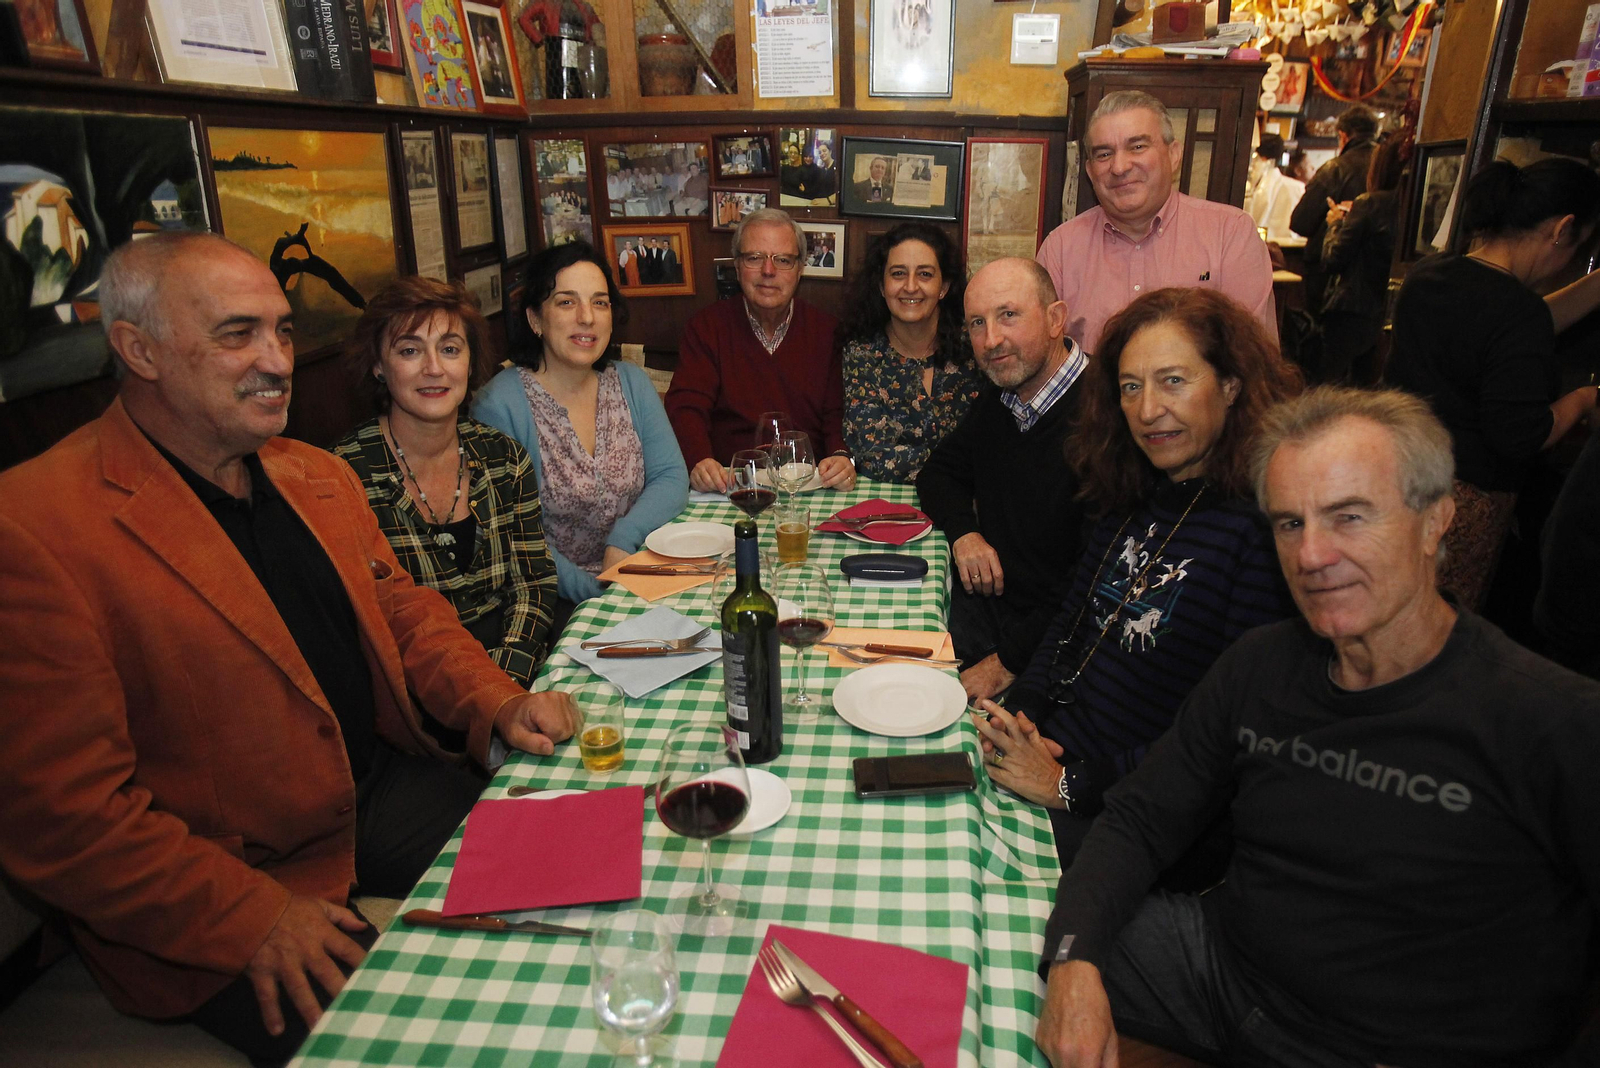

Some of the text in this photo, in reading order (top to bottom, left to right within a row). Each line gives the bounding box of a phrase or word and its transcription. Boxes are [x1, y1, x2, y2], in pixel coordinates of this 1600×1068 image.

[349, 16, 363, 52] LUIS
[773, 18, 795, 26] LEYES
[797, 17, 810, 25] DEL
[1291, 735, 1473, 812] balance
